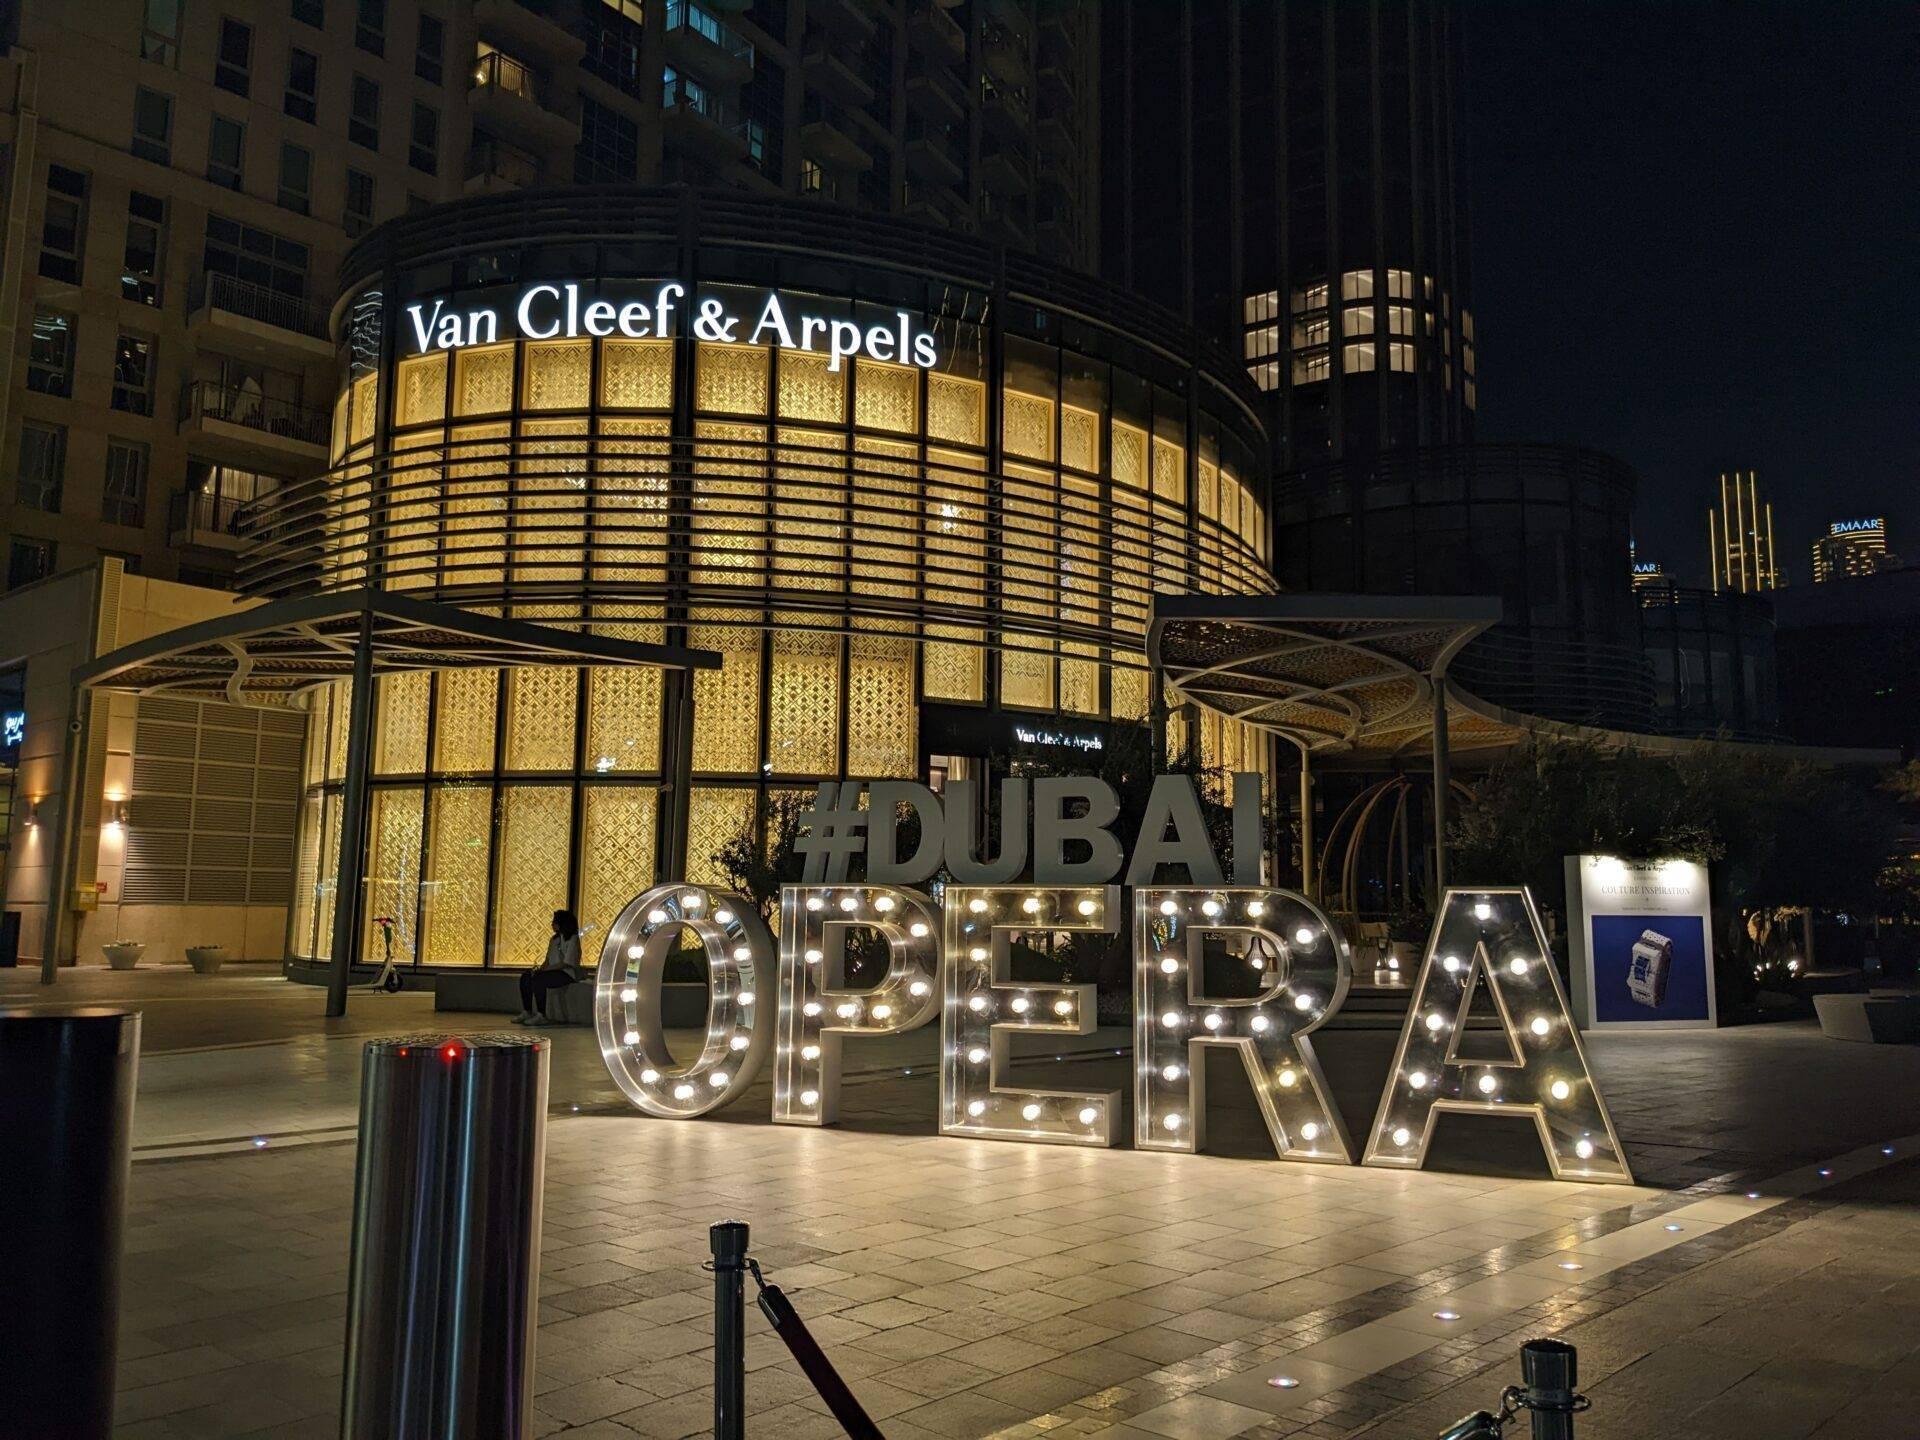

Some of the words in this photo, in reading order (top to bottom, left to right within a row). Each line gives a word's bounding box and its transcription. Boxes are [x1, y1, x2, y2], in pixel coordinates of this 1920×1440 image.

[407, 299, 497, 354] Van
[517, 283, 684, 340] Cleef
[692, 299, 739, 343] &
[748, 294, 938, 373] Arpels
[1833, 518, 1879, 533] EMAAR
[1633, 562, 1657, 573] AAR
[1016, 728, 1035, 743] Van
[794, 771, 1262, 886] #DUBAI
[1601, 885, 1640, 896] COUTURE
[1641, 885, 1690, 896] INSPIRATION
[595, 881, 1635, 1185] OPERA
